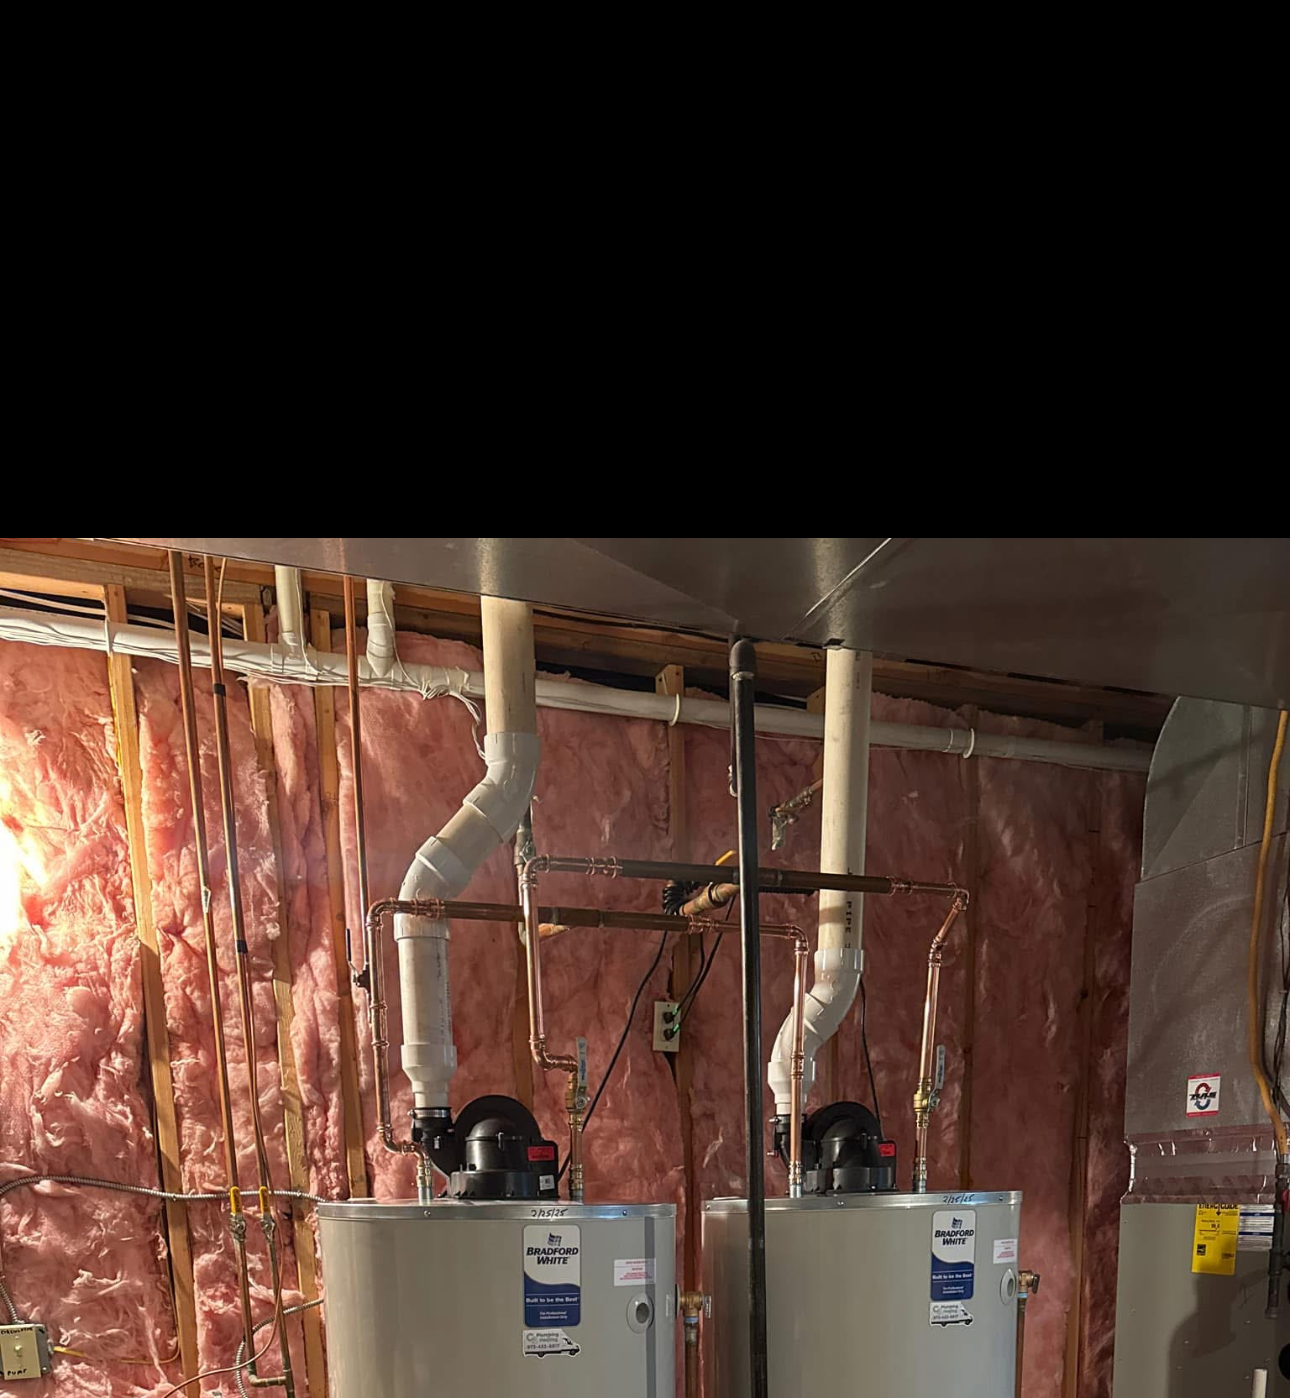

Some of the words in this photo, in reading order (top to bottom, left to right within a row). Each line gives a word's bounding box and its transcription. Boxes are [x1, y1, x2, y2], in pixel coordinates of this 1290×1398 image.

[943, 1193, 975, 1205] 2/25/25
[531, 1207, 569, 1218] 2/25/25
[934, 1230, 975, 1238] BRADFORD
[942, 1237, 966, 1246] WHITE
[526, 1246, 579, 1256] BRADFORD
[537, 1256, 569, 1265] WHITE
